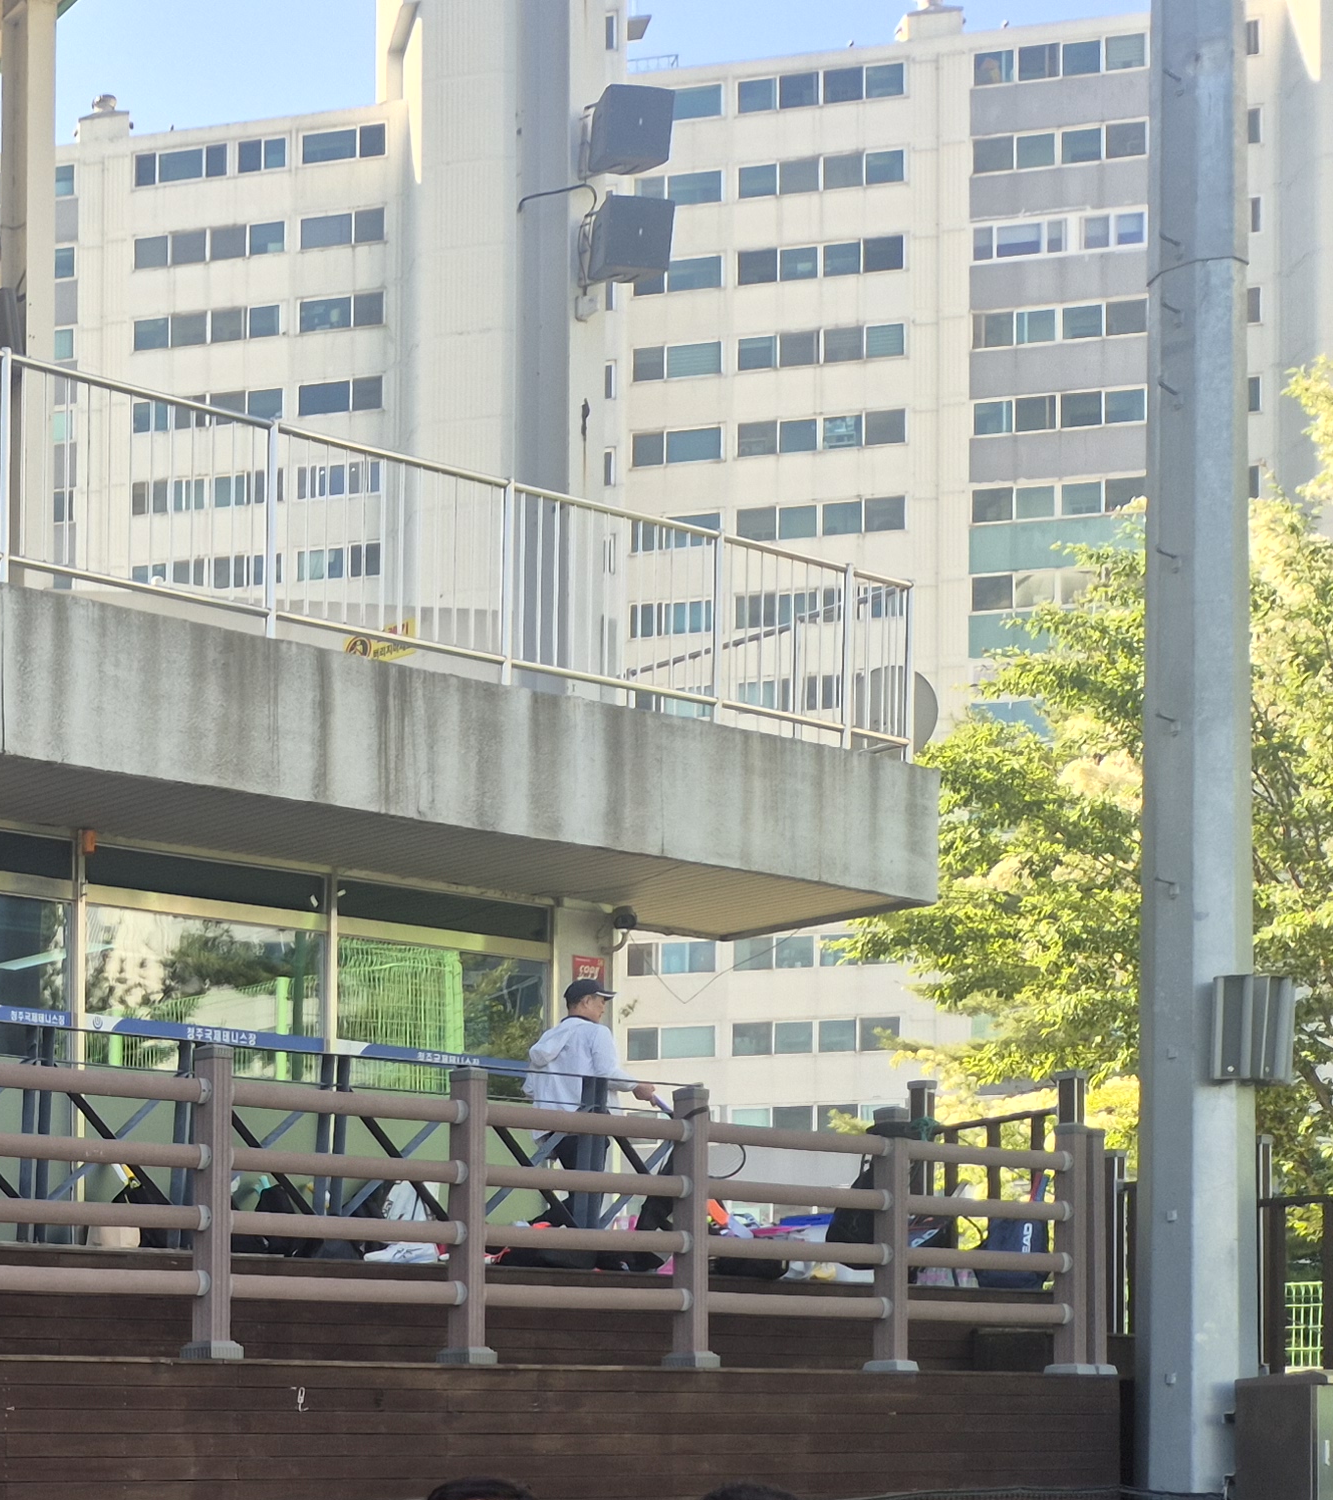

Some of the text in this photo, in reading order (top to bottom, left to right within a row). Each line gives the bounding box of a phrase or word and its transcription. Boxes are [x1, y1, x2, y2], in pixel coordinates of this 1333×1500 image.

[10, 1010, 65, 1025] 청주국제테니스장
[186, 1027, 257, 1046] 청주국제테니스장
[1022, 1222, 1033, 1253] EAD
